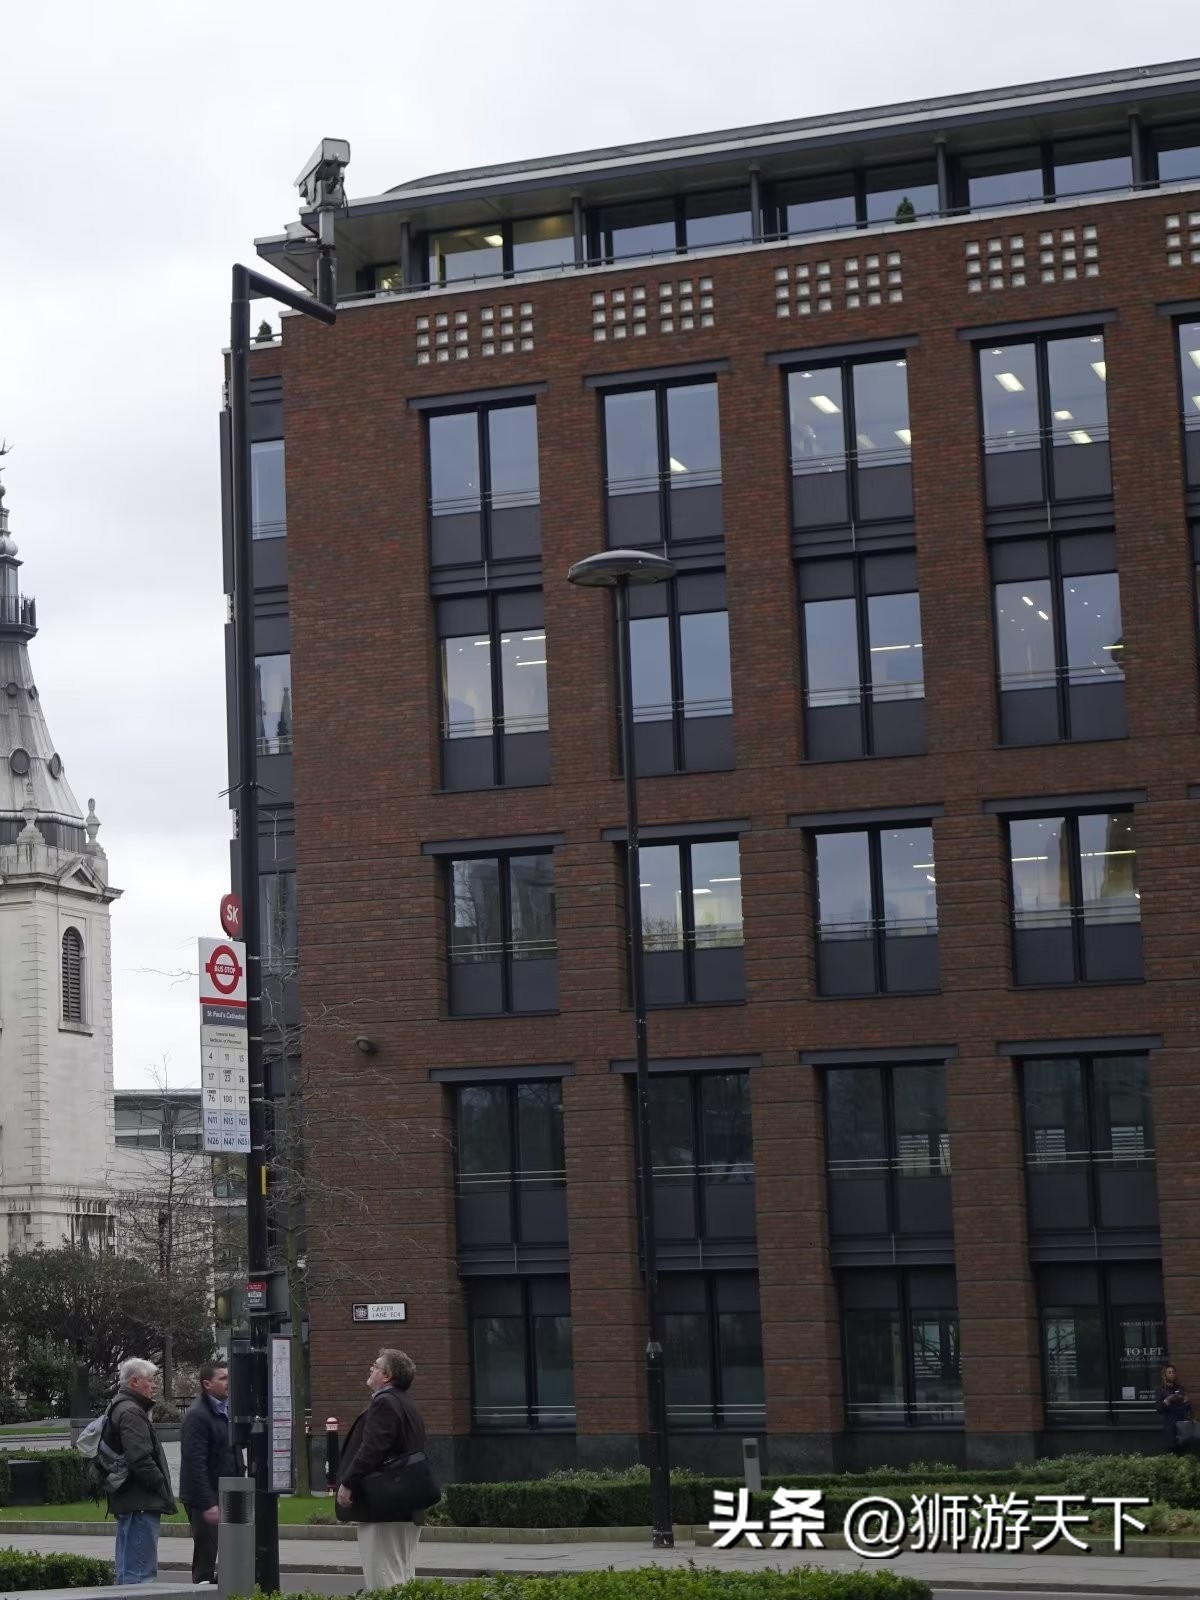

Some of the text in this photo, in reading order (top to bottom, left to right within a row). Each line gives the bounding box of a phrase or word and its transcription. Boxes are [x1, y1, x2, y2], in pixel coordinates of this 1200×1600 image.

[226, 904, 239, 924] SK
[214, 964, 236, 975] BUS STOP
[213, 1011, 225, 1019] Paul's
[226, 1012, 245, 1020] Cathedral
[208, 1116, 217, 1124] N11
[224, 1117, 233, 1125] N15
[1125, 1347, 1163, 1355] TO LET
